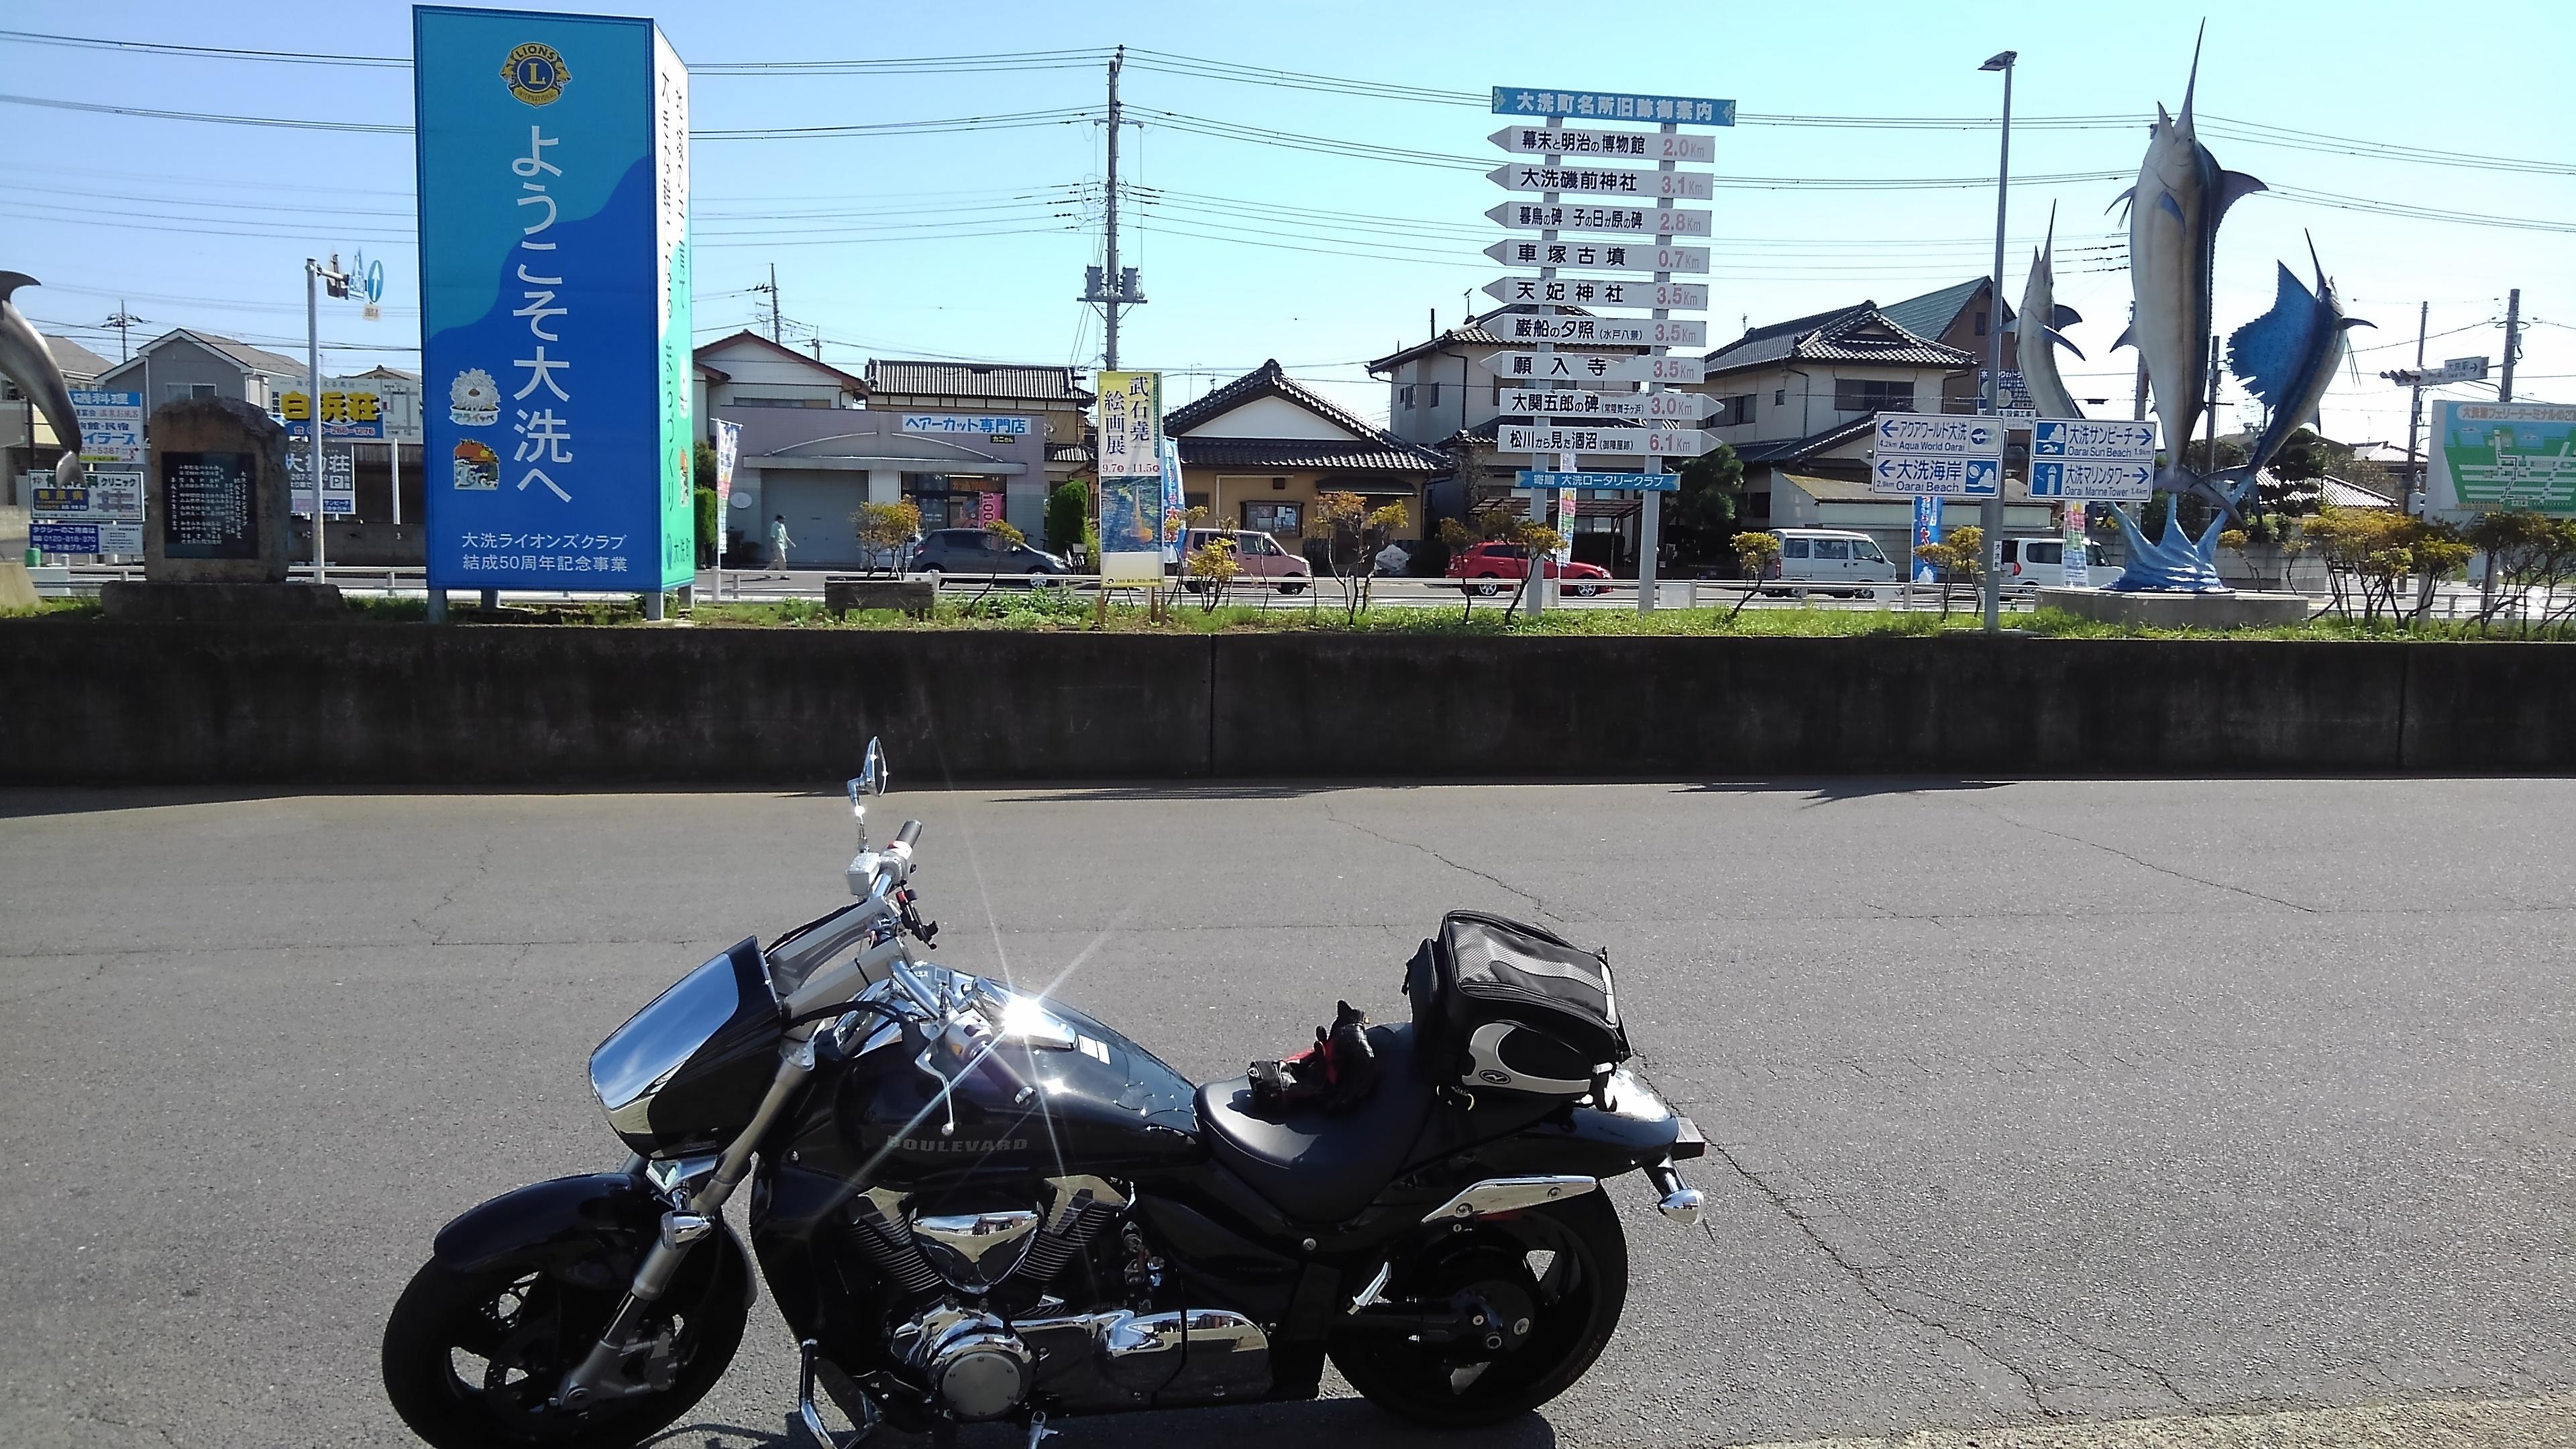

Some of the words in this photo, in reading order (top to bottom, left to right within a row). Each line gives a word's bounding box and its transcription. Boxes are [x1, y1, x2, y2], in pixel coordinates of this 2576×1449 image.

[516, 46, 555, 62] LIONS
[529, 63, 546, 85] L
[1517, 92, 1713, 121] 大洗町名所旧跡御案内
[1522, 130, 1646, 154] 幕末と明治の博物館
[1520, 168, 1638, 191] 大洗磯前神社
[1519, 206, 1562, 226] 暮鳥の碑
[1517, 243, 1625, 266] 車塚古墳
[1516, 281, 1623, 303] 天妃神社
[512, 125, 572, 502] ようこそ大洗へ
[1514, 318, 1595, 339] 巌船の夕照
[1513, 356, 1607, 376] 願入寺
[1511, 392, 1599, 413] 大関五郎の碑
[906, 417, 1026, 433] ヘアーカット専門店
[1104, 390, 1126, 455] 絵画展
[1900, 421, 1967, 440] アクアワールド大洗
[1509, 429, 1598, 449] 松川から見た涸沼
[2069, 424, 2133, 445] 大洗サンビーチ
[1898, 441, 1919, 451] Aqua
[1921, 441, 1943, 451] World
[1945, 442, 1965, 451] Oarai
[2068, 446, 2089, 456] Oarai
[2090, 447, 2105, 457] Sun
[2106, 447, 2131, 458] Beach
[287, 453, 350, 473] 大荘
[1896, 459, 1962, 480] 大洗海岸
[101, 478, 136, 487] クリニック
[1534, 474, 1555, 486] 寄贈
[1562, 475, 1664, 487] 大洗ロータリークラブ
[2065, 464, 2130, 484] 大洗マリンタワー
[1896, 481, 1924, 491] Oarai
[1926, 482, 1959, 492] Beach
[2065, 486, 2082, 496] Oarai
[2086, 486, 2108, 496] Marine
[2108, 487, 2128, 497] Tower
[462, 532, 628, 550] 大洗ライオンズクラブ
[463, 553, 628, 572] 結成50周年記念事業
[888, 1135, 1028, 1152] BOULEVARD
